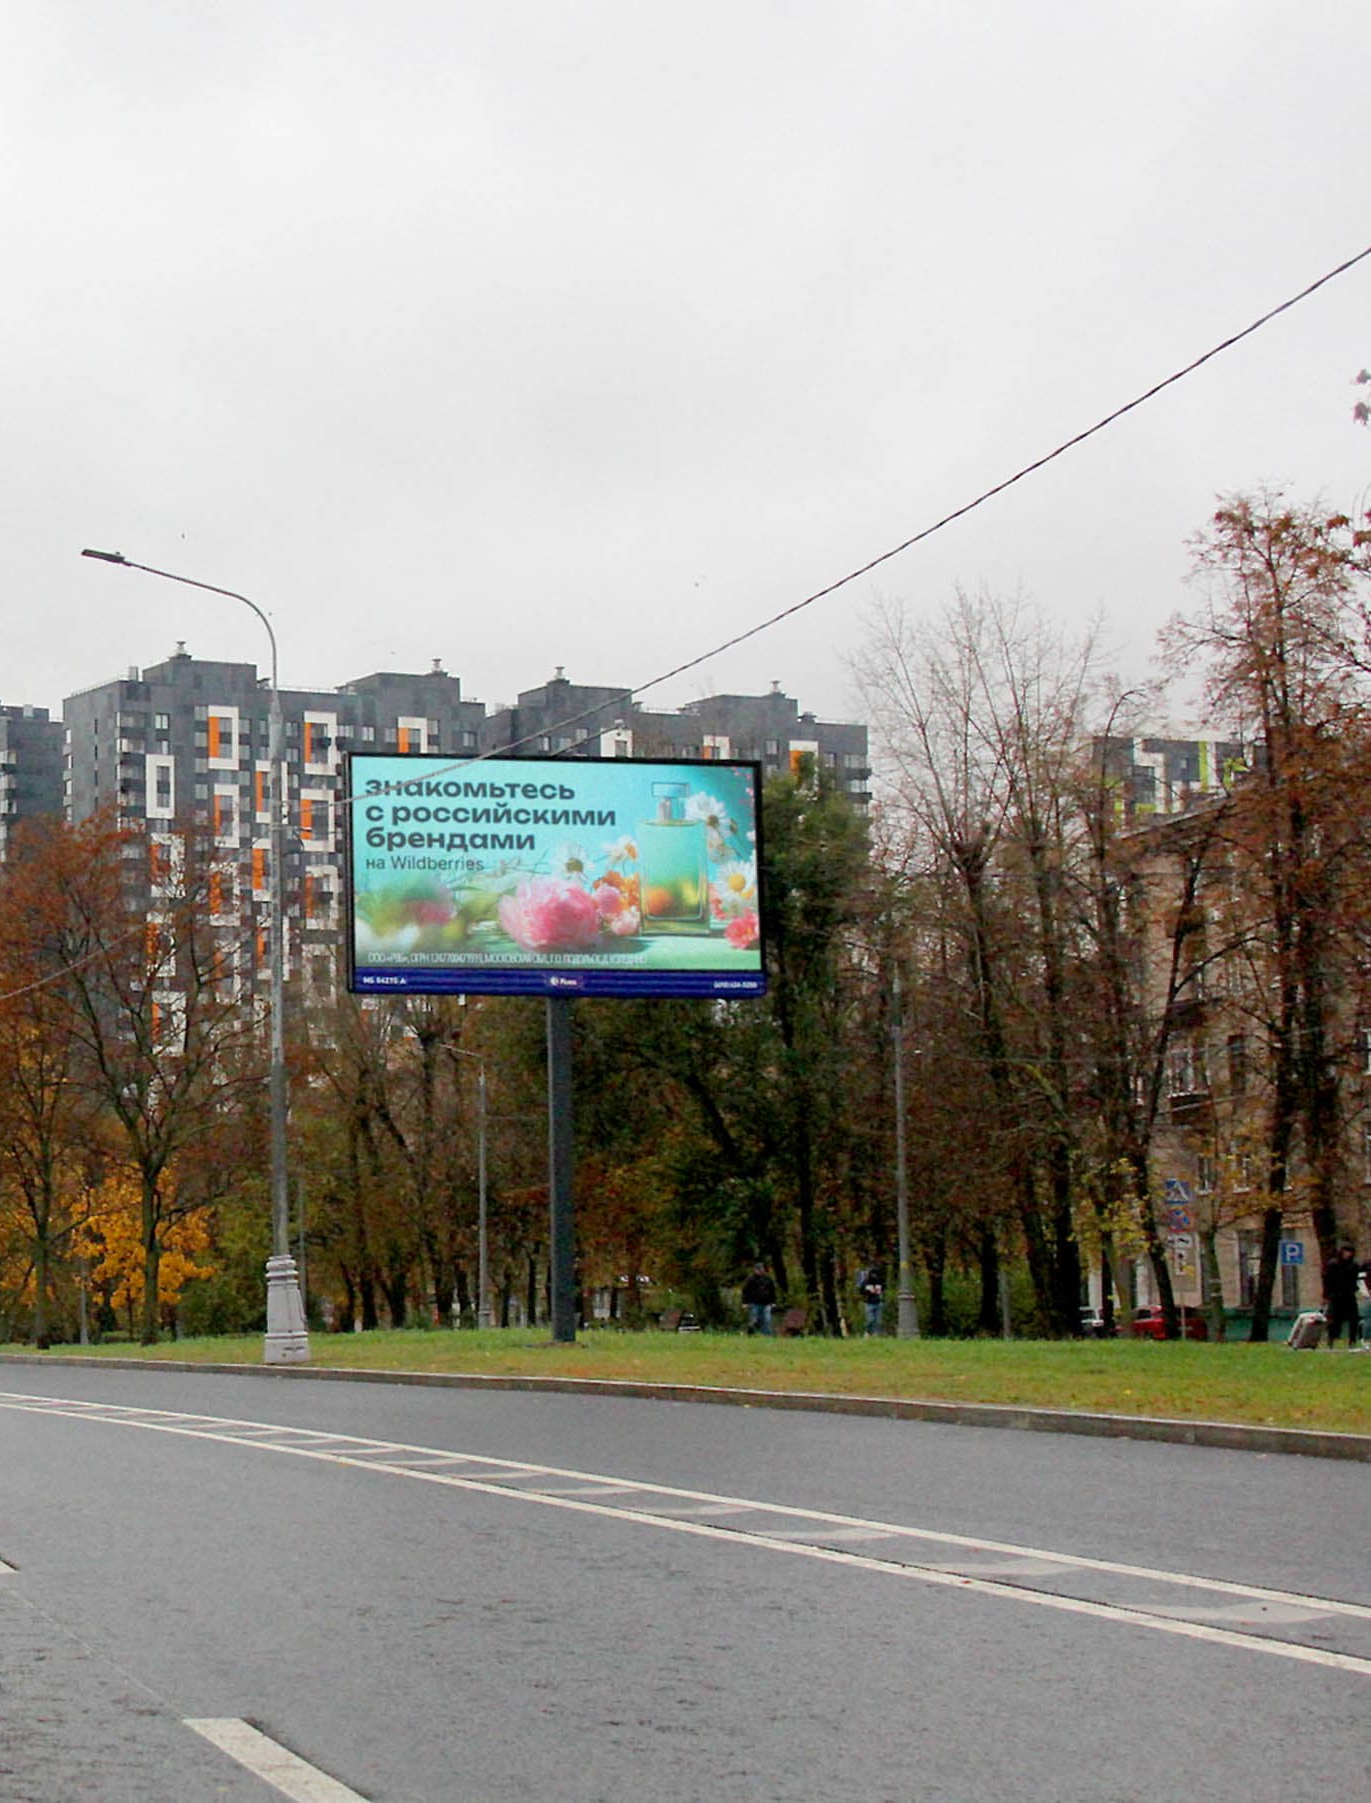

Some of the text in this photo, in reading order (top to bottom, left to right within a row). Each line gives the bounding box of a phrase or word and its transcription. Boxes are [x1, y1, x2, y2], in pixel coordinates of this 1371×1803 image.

[365, 779, 576, 800] знакомьтесь
[365, 802, 616, 826] с российскими
[365, 826, 536, 852] брендами
[365, 856, 486, 872] на Wildberries
